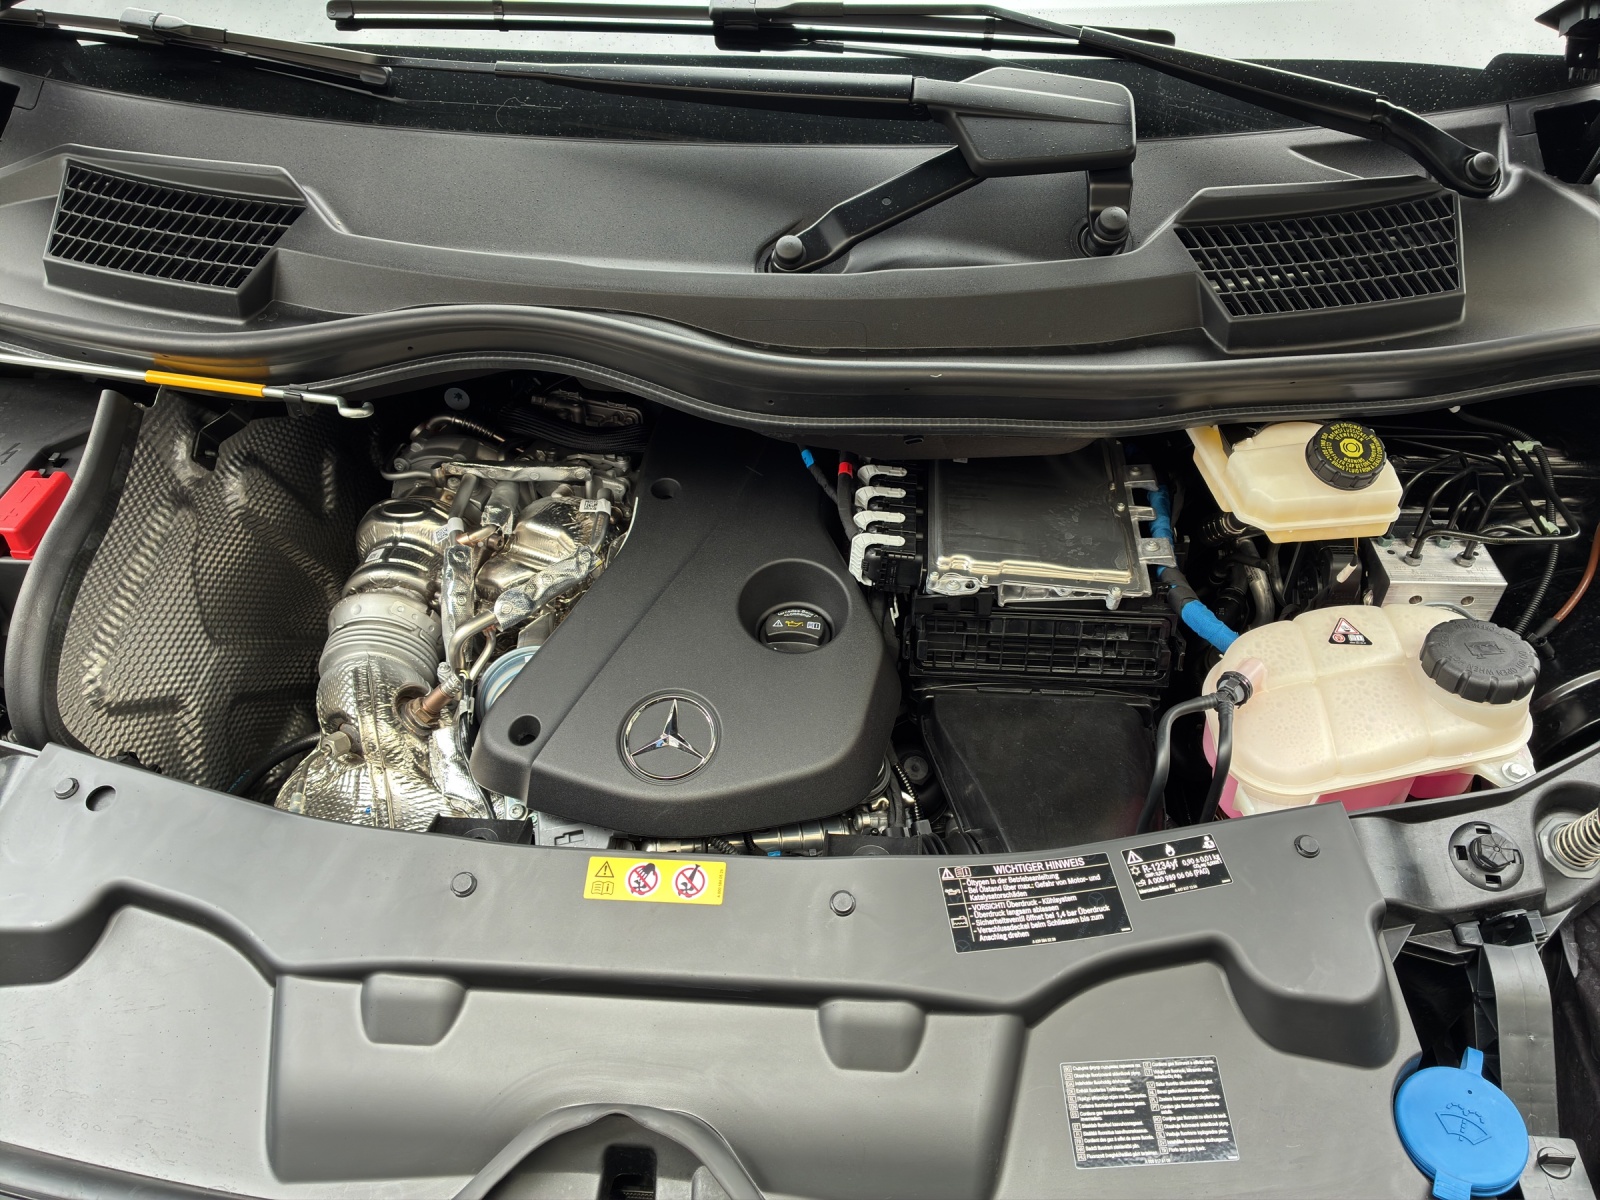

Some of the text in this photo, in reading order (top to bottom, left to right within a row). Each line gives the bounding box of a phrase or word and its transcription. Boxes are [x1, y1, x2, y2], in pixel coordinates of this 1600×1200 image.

[993, 857, 1085, 874] WICHTIGER HINWEIS
[1142, 859, 1178, 873] R-1234yf
[1068, 876, 1088, 884] Motor-
[1078, 905, 1110, 915] Überdruck
